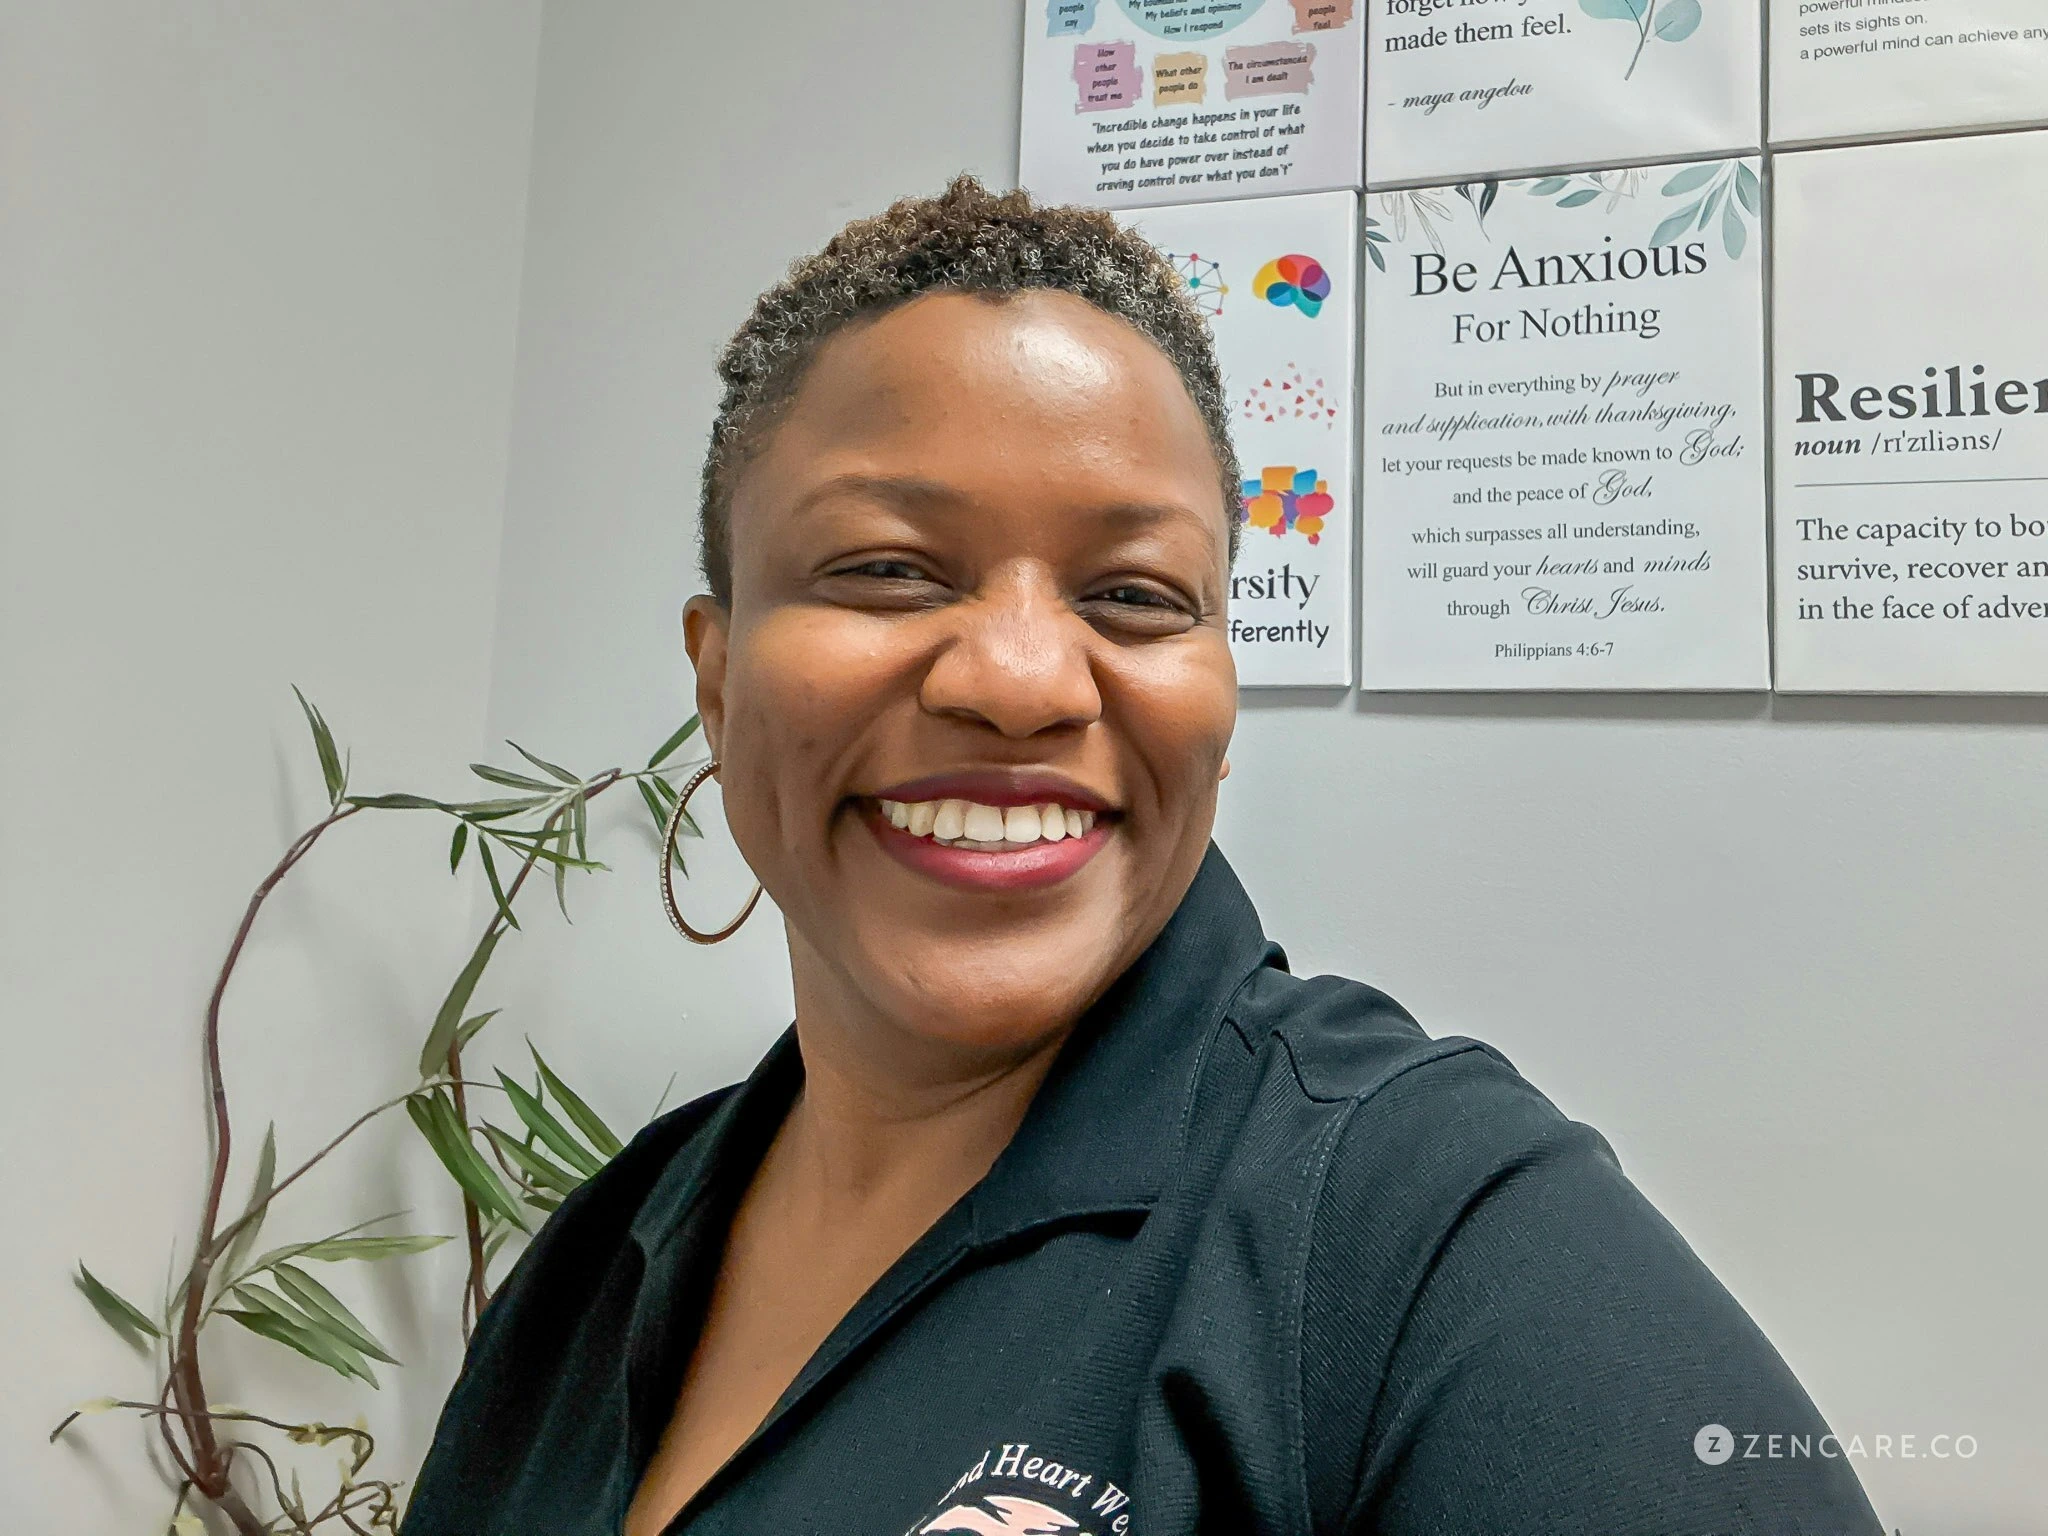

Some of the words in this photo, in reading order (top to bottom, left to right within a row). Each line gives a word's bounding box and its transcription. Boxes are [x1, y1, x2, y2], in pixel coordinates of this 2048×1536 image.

[1145, 11, 1157, 21] My
[1190, 6, 1205, 15] and
[1308, 5, 1336, 18] people
[1799, 24, 1830, 36] sets
[1835, 21, 1851, 32] its
[1856, 16, 1900, 31] sights
[1905, 14, 1928, 25] on.
[1163, 25, 1180, 34] How
[1190, 20, 1223, 32] respond
[1385, 26, 1447, 52] made
[1455, 22, 1513, 44] them
[1521, 13, 1571, 37] feel.
[1800, 49, 1809, 60] a
[1814, 39, 1878, 60] powerful
[1882, 35, 1920, 50] mind
[1925, 34, 1953, 46] can
[1958, 29, 2018, 43] achieve
[1095, 63, 1117, 72] other
[1156, 68, 1178, 78] What
[1180, 66, 1202, 76] other
[1228, 61, 1243, 71] The
[1266, 71, 1288, 82] dealt
[1092, 77, 1118, 90] people
[1159, 83, 1185, 95] people
[1188, 81, 1198, 90] do
[1403, 92, 1455, 116] maya
[1459, 78, 1534, 110] angelou
[1092, 119, 1148, 134] "Incredible
[1151, 116, 1188, 129] change
[1192, 113, 1236, 126] happens
[1239, 109, 1250, 120] in
[1253, 108, 1278, 122] your
[1282, 104, 1301, 116] life
[1087, 142, 1114, 154] when
[1117, 141, 1136, 154] you
[1140, 136, 1174, 149] decide
[1178, 135, 1190, 145] to
[1193, 132, 1217, 144] take
[1221, 127, 1259, 141] control
[1263, 125, 1275, 137] of
[1278, 123, 1305, 135] what
[1101, 162, 1120, 175] you
[1123, 159, 1136, 169] do
[1140, 157, 1164, 168] have
[1167, 155, 1201, 169] power
[1204, 152, 1229, 162] over
[1232, 145, 1273, 160] instead
[1276, 144, 1289, 156] of
[1096, 179, 1134, 191] craving
[1138, 174, 1175, 188] control
[1179, 174, 1203, 184] over
[1206, 169, 1232, 181] what
[1236, 169, 1256, 183] you
[1410, 252, 1477, 297] Be
[1489, 236, 1707, 291] Anxious
[1452, 313, 1510, 344] For
[1519, 302, 1661, 339] Nothing
[1434, 381, 1463, 398] But
[1468, 380, 1483, 395] in
[1488, 375, 1576, 396] everything
[1581, 374, 1601, 393] by
[1602, 371, 1680, 398] prayer
[1381, 413, 1426, 435] and
[1426, 411, 1543, 441] supplication,
[1546, 404, 1590, 426] with
[1595, 400, 1736, 432] thanksgiving,
[1382, 457, 1401, 472] let
[1405, 459, 1442, 475] your
[1447, 454, 1512, 473] requests
[1517, 451, 1536, 466] be
[1542, 449, 1587, 465] made
[1593, 447, 1650, 463] known
[1656, 446, 1673, 459] to
[1680, 428, 1745, 466] God;
[1794, 436, 1861, 456] noun
[1452, 488, 1482, 504] and
[1487, 487, 1512, 503] the
[1516, 487, 1564, 505] peace
[1569, 483, 1589, 500] of
[1592, 468, 1653, 506] God,
[1412, 526, 1460, 544] which
[1465, 528, 1542, 545] surpasses
[1547, 524, 1567, 540] all
[1573, 519, 1700, 538] understanding,
[1796, 518, 1849, 541] The
[1857, 516, 1967, 546] capacity
[1975, 517, 2001, 537] to
[2010, 513, 2048, 537] bo
[1407, 563, 1438, 579] will
[1442, 561, 1488, 582] guard
[1493, 564, 1532, 581] your
[1536, 555, 1598, 576] hearts
[1603, 557, 1634, 574] and
[1644, 550, 1711, 573] minds
[1797, 557, 1899, 582] survive,
[1907, 561, 2008, 578] recover
[1230, 563, 1320, 610] rsity
[1447, 599, 1510, 619] through
[1521, 586, 1594, 615] Christ
[1594, 584, 1665, 620] Jesus.
[1799, 598, 1824, 620] in
[1833, 596, 1874, 619] the
[1883, 595, 1935, 619] face
[1943, 594, 1974, 619] of
[1227, 619, 1330, 648] ferently
[1495, 642, 1571, 660] Philippians
[1576, 642, 1614, 656] 4:6-7
[990, 1444, 1093, 1498] Heart
[1091, 1482, 1130, 1536] We
